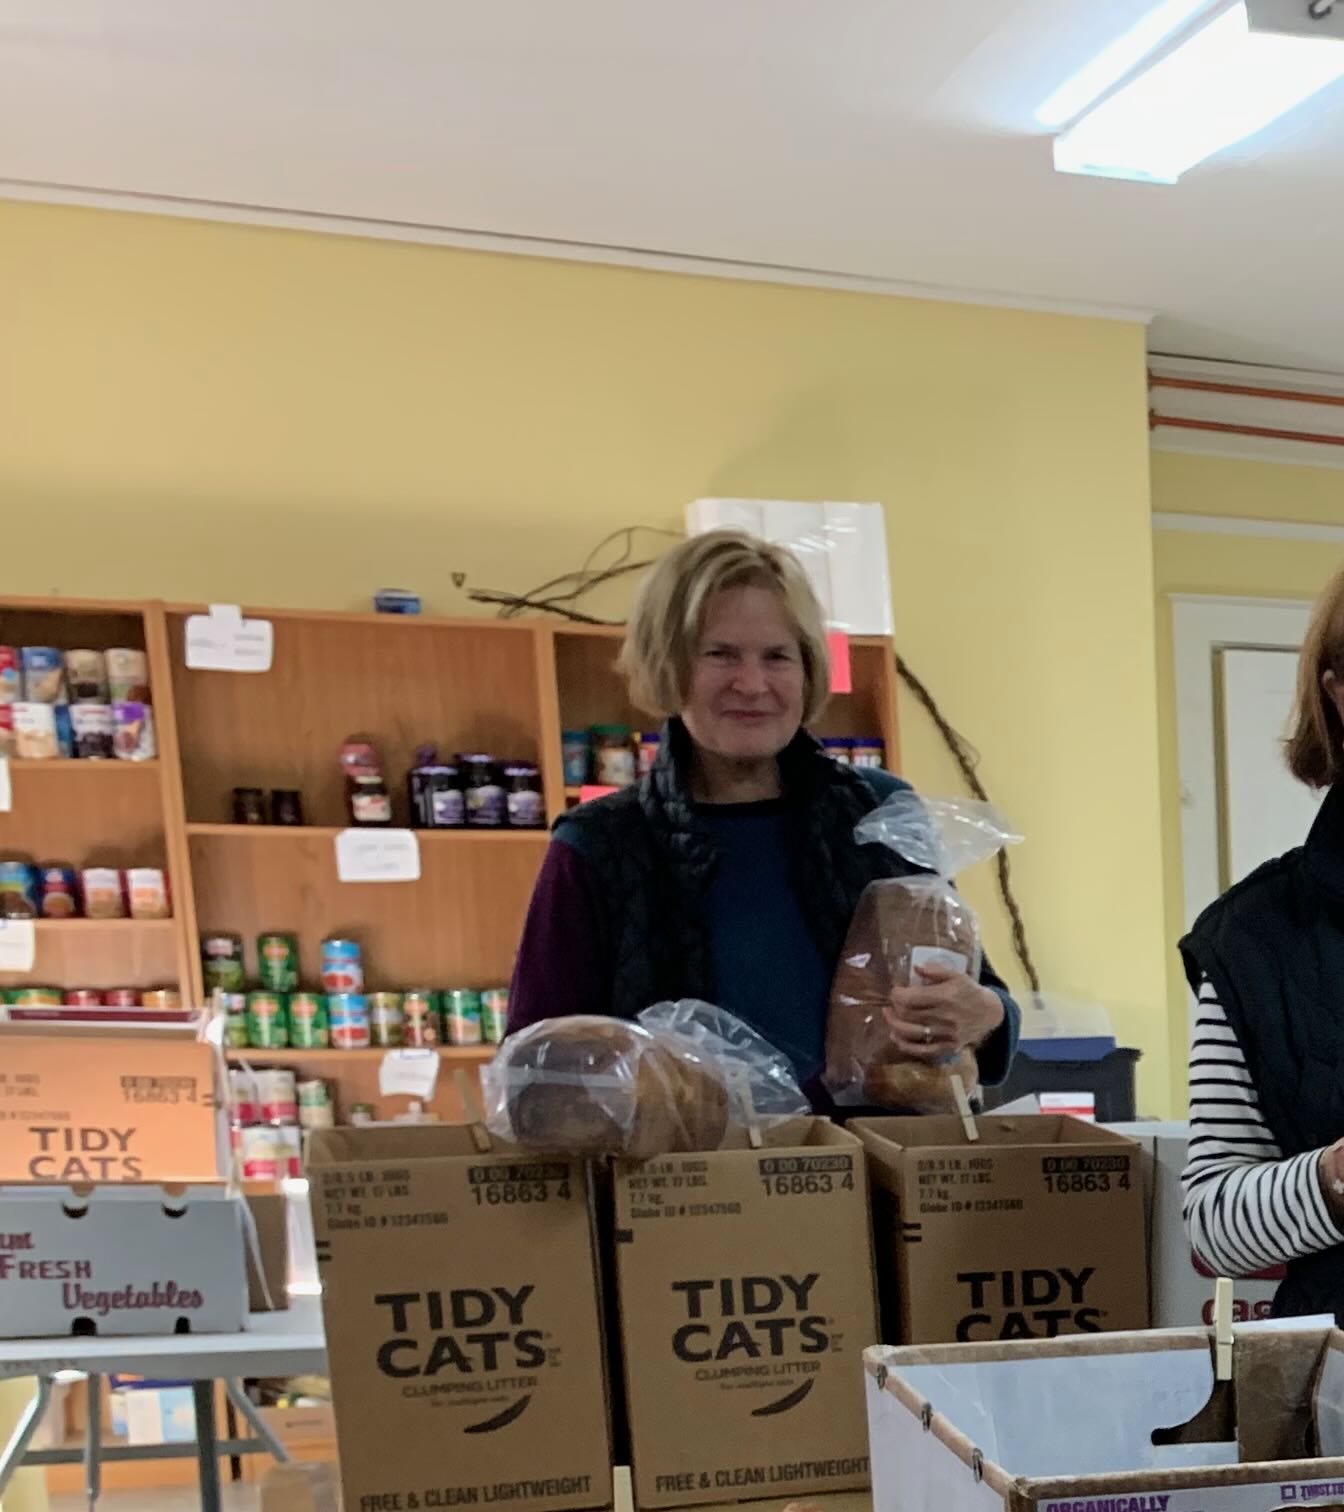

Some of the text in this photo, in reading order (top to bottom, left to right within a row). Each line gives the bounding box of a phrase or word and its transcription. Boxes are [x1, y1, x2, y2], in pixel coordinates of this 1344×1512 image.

[29, 1126, 137, 1152] TIDY
[28, 1156, 143, 1181] CATS
[761, 1173, 854, 1197] 16863 4
[1044, 1173, 1132, 1194] 16863 4
[62, 1279, 205, 1316] Vegetables
[671, 1273, 821, 1318] TIDY
[957, 1267, 1097, 1309] TIDY
[374, 1284, 536, 1333] TIDY
[955, 1307, 1104, 1343] CATS
[376, 1329, 547, 1379] CATS
[672, 1315, 830, 1363] CATS
[486, 1375, 538, 1392] LITTER
[696, 1360, 822, 1381] CLUMPING LITTER
[424, 1487, 479, 1508] CLEAN
[483, 1475, 592, 1503] LIGHTWEIGHT
[656, 1473, 695, 1493] FREE
[715, 1467, 766, 1488] CLEAN
[769, 1455, 870, 1483] LIGHTWEIGHT
